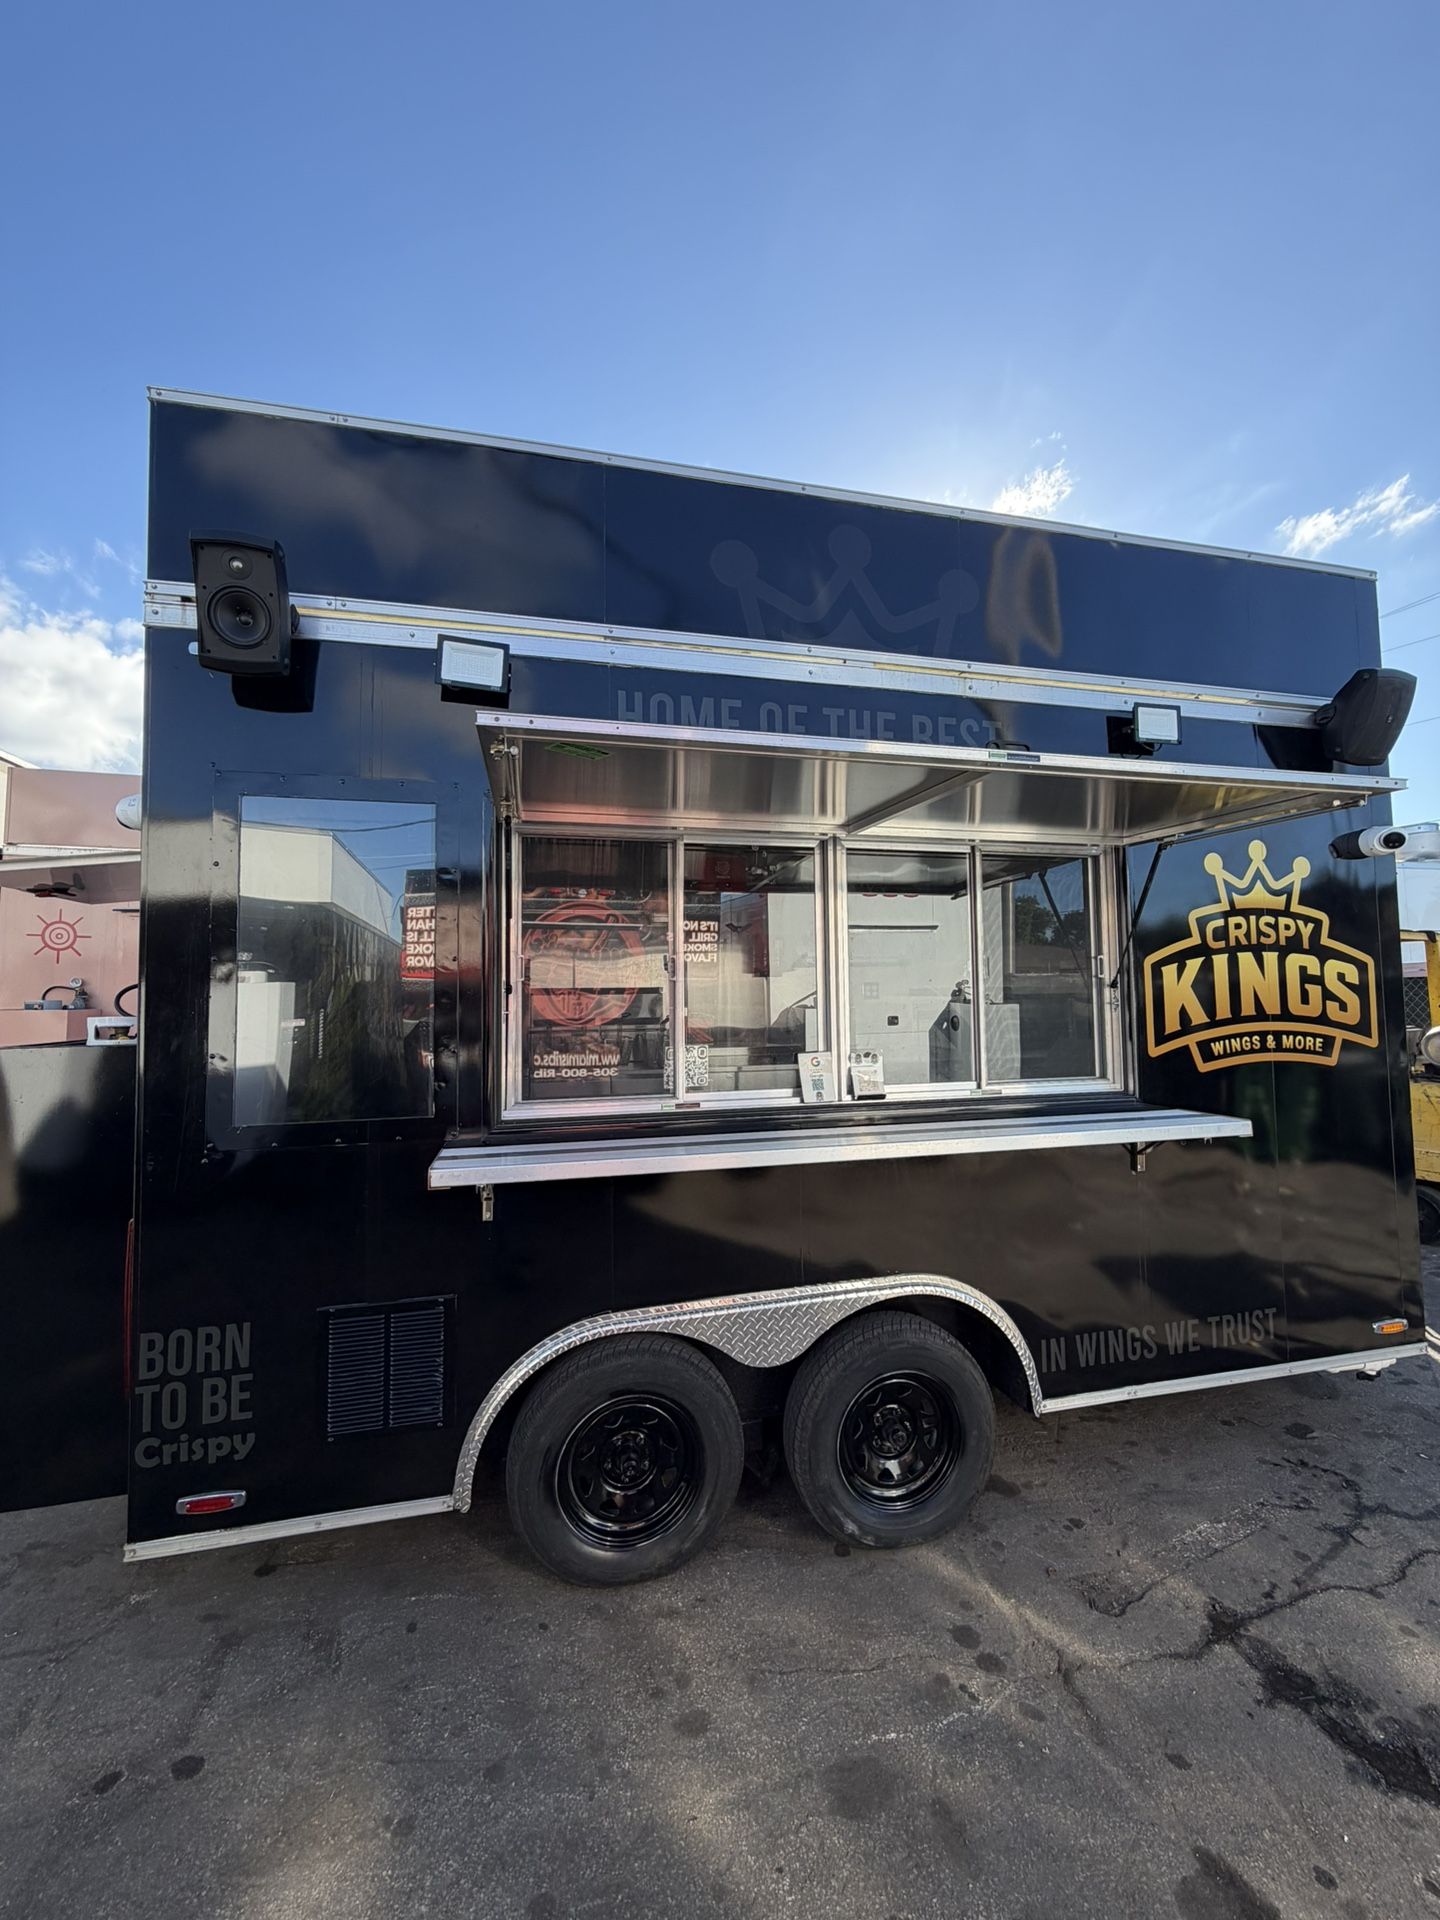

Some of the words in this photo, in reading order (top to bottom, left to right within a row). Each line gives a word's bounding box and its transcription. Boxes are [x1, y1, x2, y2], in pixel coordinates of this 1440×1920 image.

[617, 690, 742, 729] HOME
[759, 702, 808, 733] OF
[822, 707, 896, 741] THE
[911, 714, 1002, 746] BEST
[1206, 915, 1315, 950] CRISPY
[1161, 951, 1361, 1035] KINGS
[1210, 1036, 1261, 1056] WINGS
[1266, 1035, 1277, 1049] &
[1282, 1034, 1324, 1052] MORE
[138, 1322, 252, 1380] BORN
[1041, 1337, 1066, 1373] IN
[1075, 1325, 1158, 1369] WINGS
[1164, 1319, 1199, 1355] WE
[1208, 1308, 1277, 1347] TRUST
[134, 1382, 187, 1433] TO
[202, 1374, 253, 1425] BE
[134, 1432, 256, 1469] Crispy
